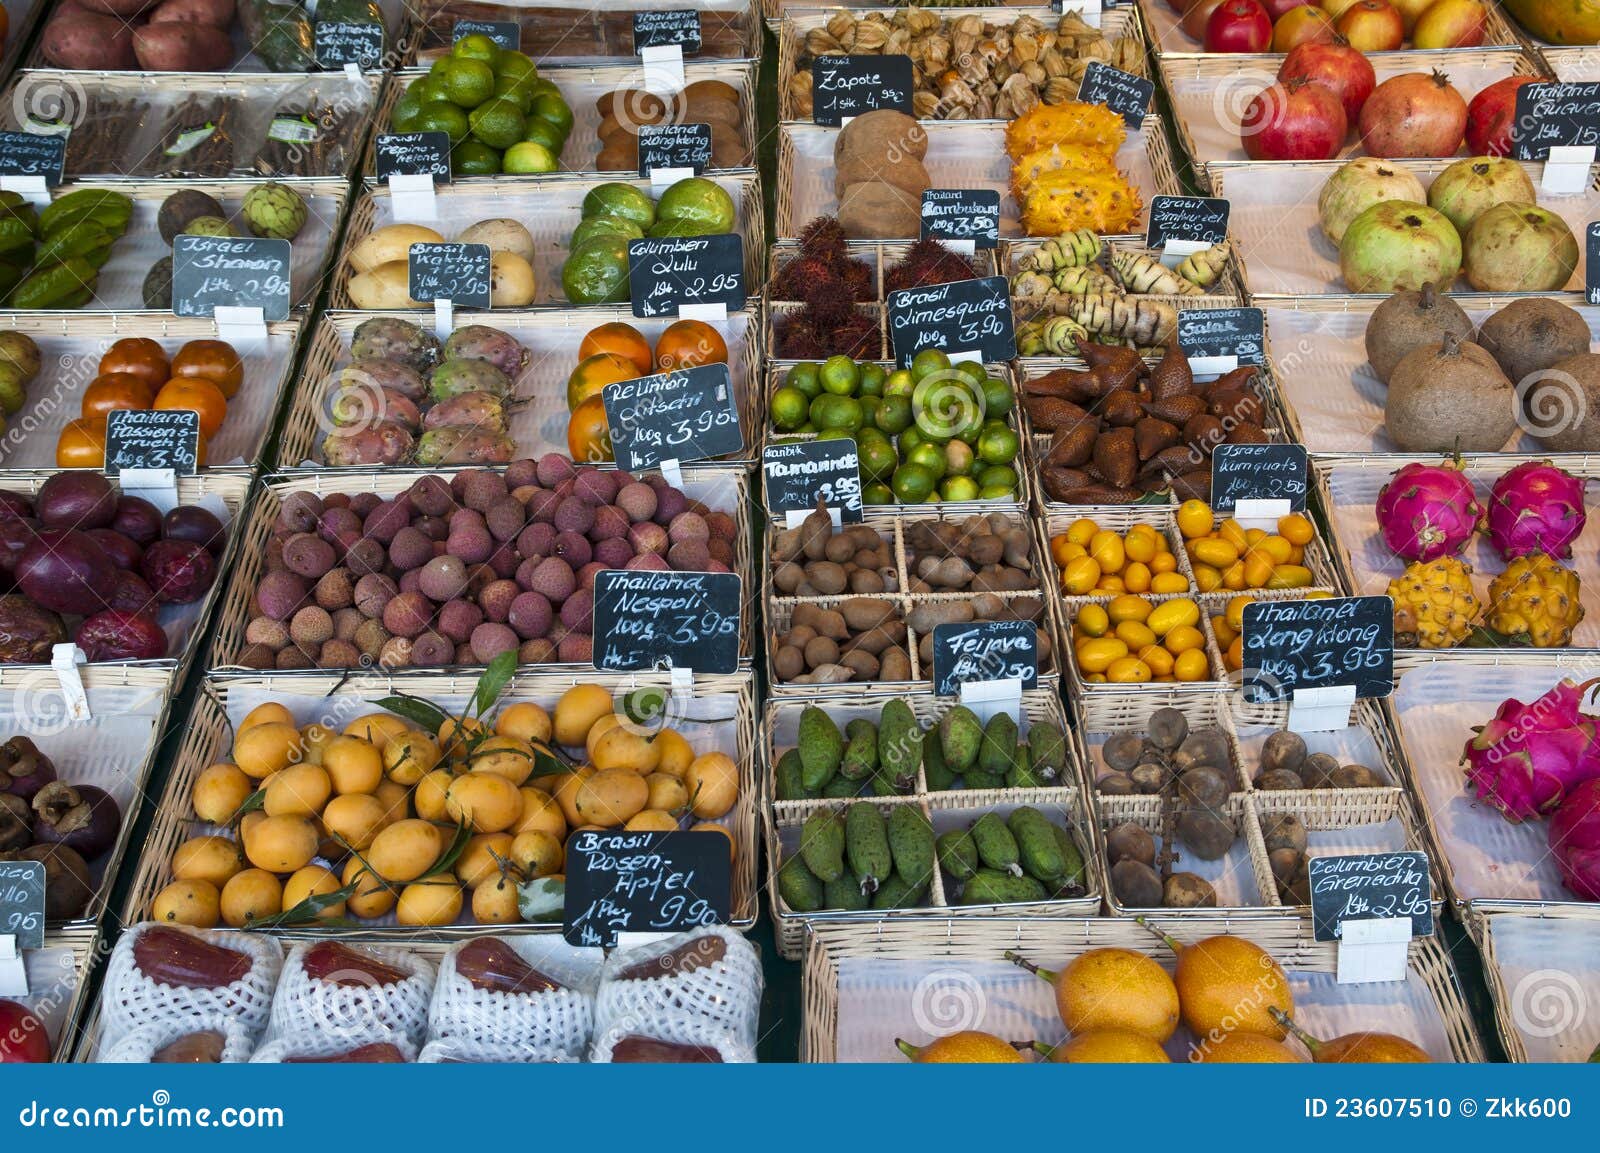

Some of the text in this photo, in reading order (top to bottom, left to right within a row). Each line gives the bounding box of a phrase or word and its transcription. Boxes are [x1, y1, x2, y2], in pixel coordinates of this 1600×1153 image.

[819, 70, 882, 90] Zapote
[1527, 82, 1600, 100] Thailand
[182, 238, 255, 253] Israel
[409, 243, 466, 255] Brasil
[630, 239, 709, 256] Columbien
[651, 254, 698, 275] Lulu
[684, 273, 741, 297] 2.95
[896, 285, 950, 308] Brasil
[895, 291, 1007, 328] Limesquats
[914, 314, 1004, 350] 100g 3.90
[114, 410, 194, 426] Thailand
[629, 427, 662, 448] 100g
[1221, 445, 1270, 456] Israel
[764, 453, 858, 478] Tamarinde
[606, 572, 704, 591] Thailand
[613, 592, 707, 618] Nespoli
[1256, 599, 1362, 622] Thailand
[606, 617, 655, 641] 100g
[1302, 646, 1391, 679] 3.95
[576, 832, 653, 851] Brasil
[586, 851, 672, 872] Rosen-
[1315, 868, 1422, 893] Grenadilla
[650, 896, 717, 926] 9.90
